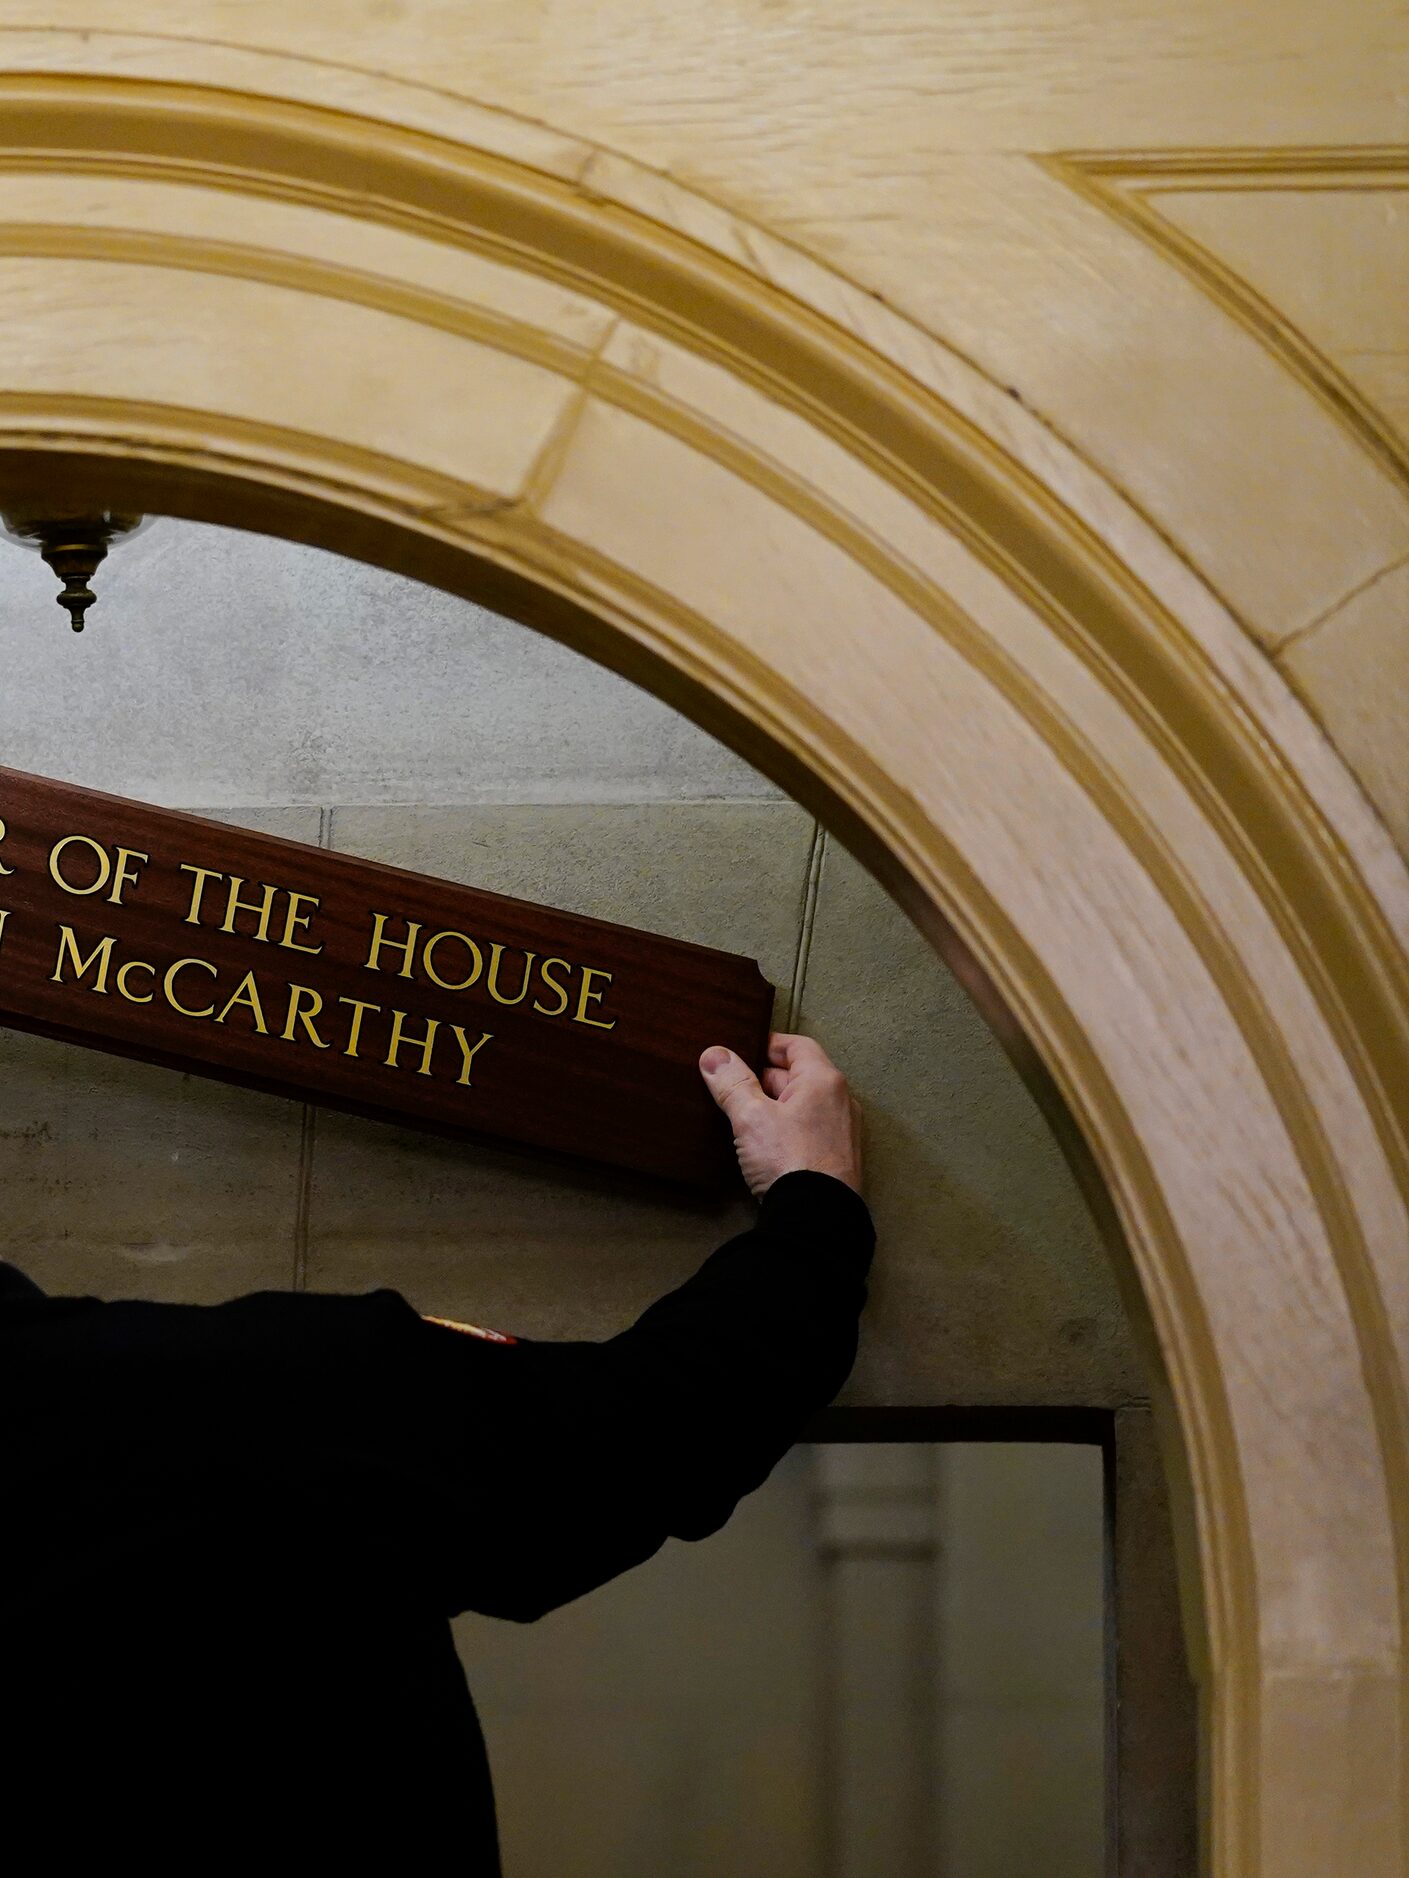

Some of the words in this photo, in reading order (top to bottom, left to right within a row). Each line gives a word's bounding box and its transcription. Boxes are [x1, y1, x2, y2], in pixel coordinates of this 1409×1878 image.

[49, 835, 149, 905] OF
[180, 863, 325, 955] THE
[364, 912, 617, 1030] HOUSE
[50, 924, 495, 1086] McCARTHY
